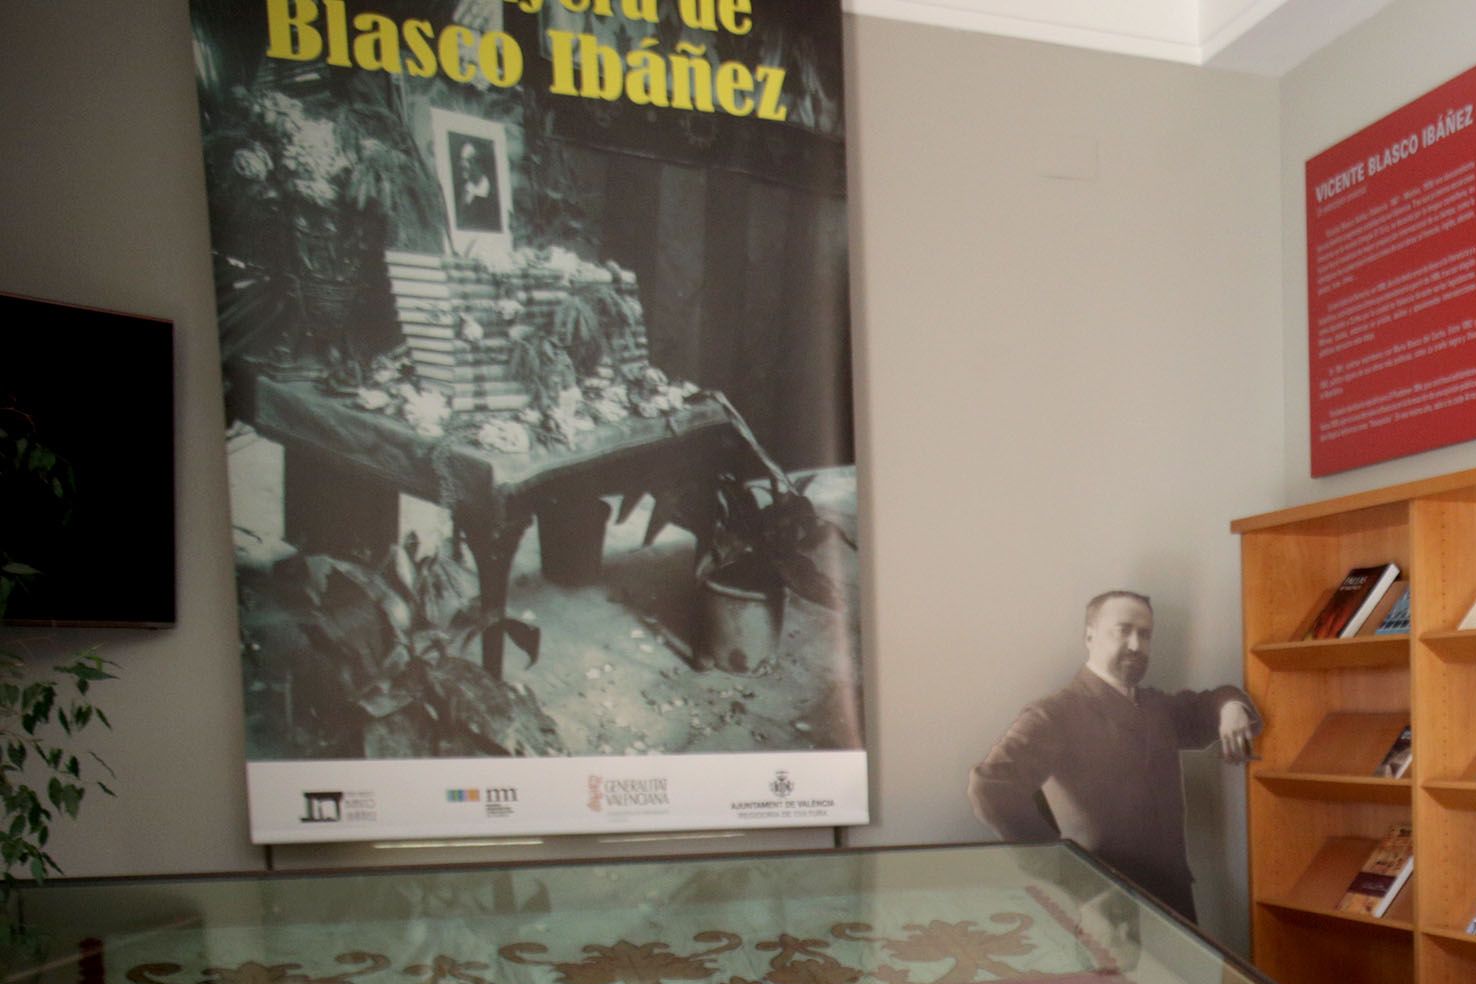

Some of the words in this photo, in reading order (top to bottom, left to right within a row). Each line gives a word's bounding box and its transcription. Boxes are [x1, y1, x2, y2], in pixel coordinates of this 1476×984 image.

[266, 0, 523, 88] Blasco
[548, 28, 787, 122] Ibáñez
[1315, 162, 1365, 203] VICENTE
[1368, 134, 1419, 176] BLASCO
[1422, 103, 1474, 148] IBÁÑEZ
[604, 778, 668, 793] GENERALITAT
[605, 793, 670, 807] VALENCIANA
[731, 801, 784, 811] AJUNTAMENT
[785, 801, 796, 809] DE
